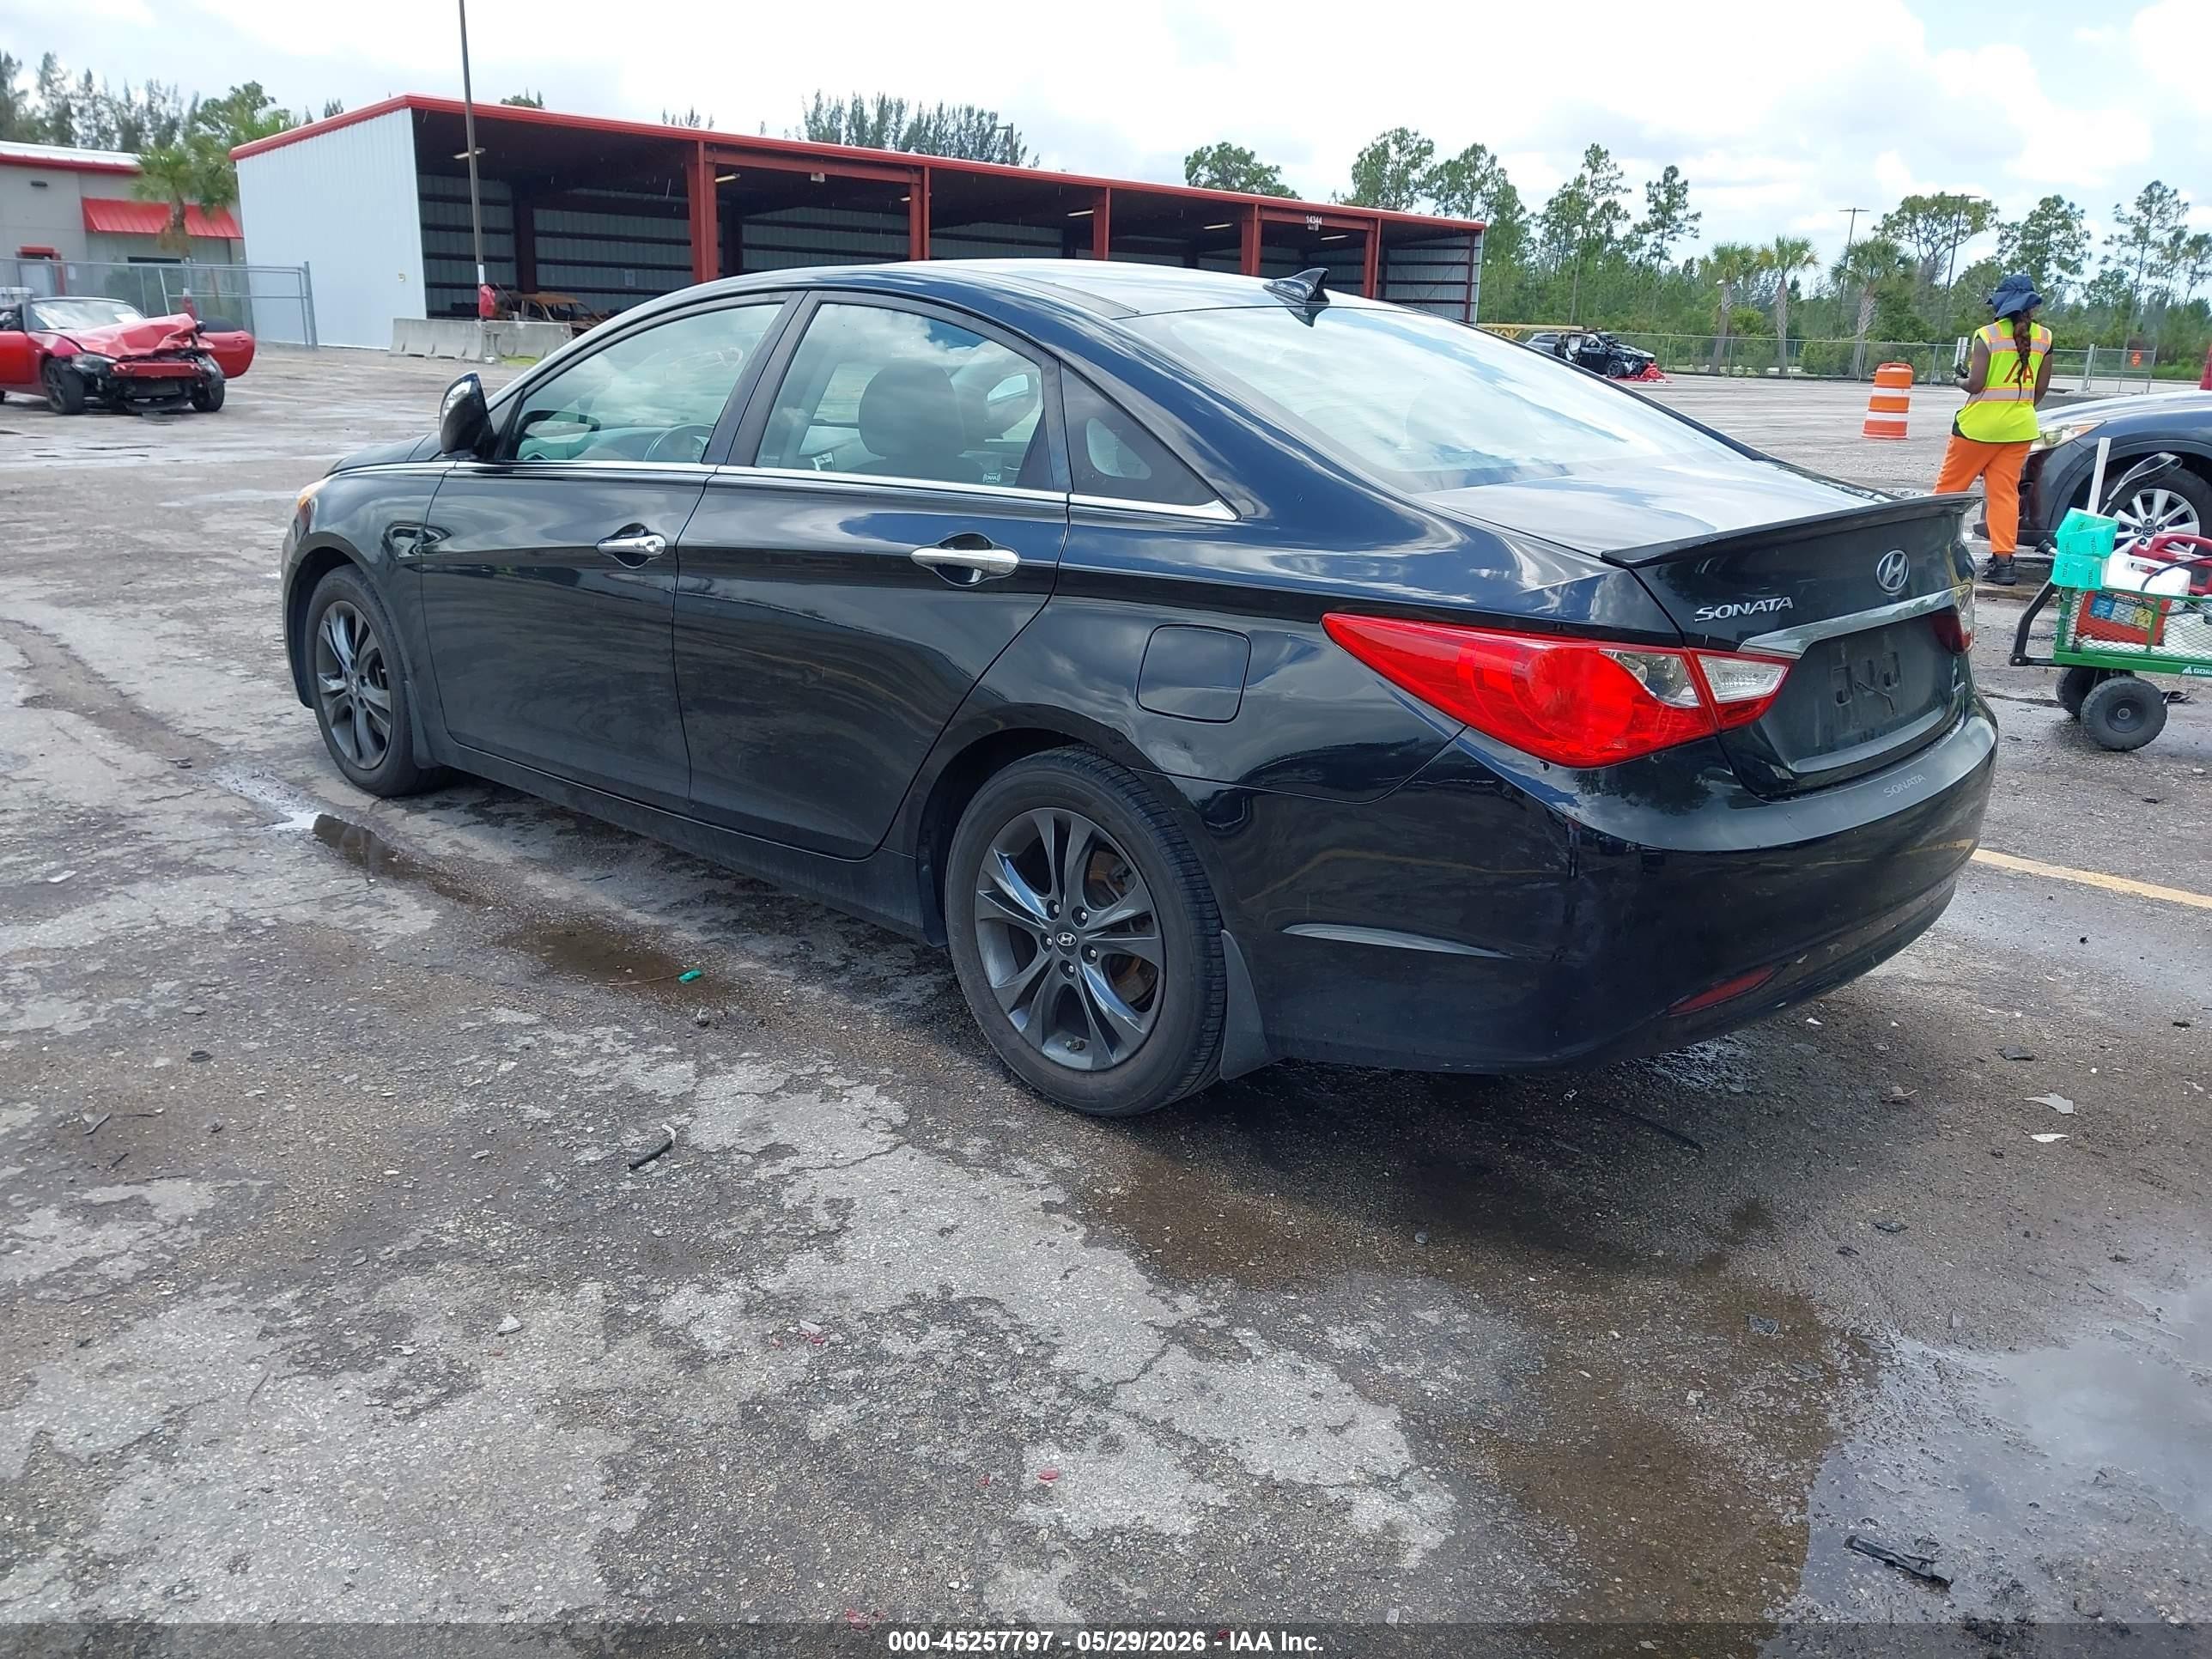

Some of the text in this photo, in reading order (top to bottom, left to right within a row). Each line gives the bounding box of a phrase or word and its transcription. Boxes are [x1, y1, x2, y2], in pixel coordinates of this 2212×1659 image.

[1305, 215, 1322, 225] 14344
[1694, 597, 1794, 623] SONATA
[2193, 667, 2212, 676] GOR
[1883, 775, 1926, 798] SONATA
